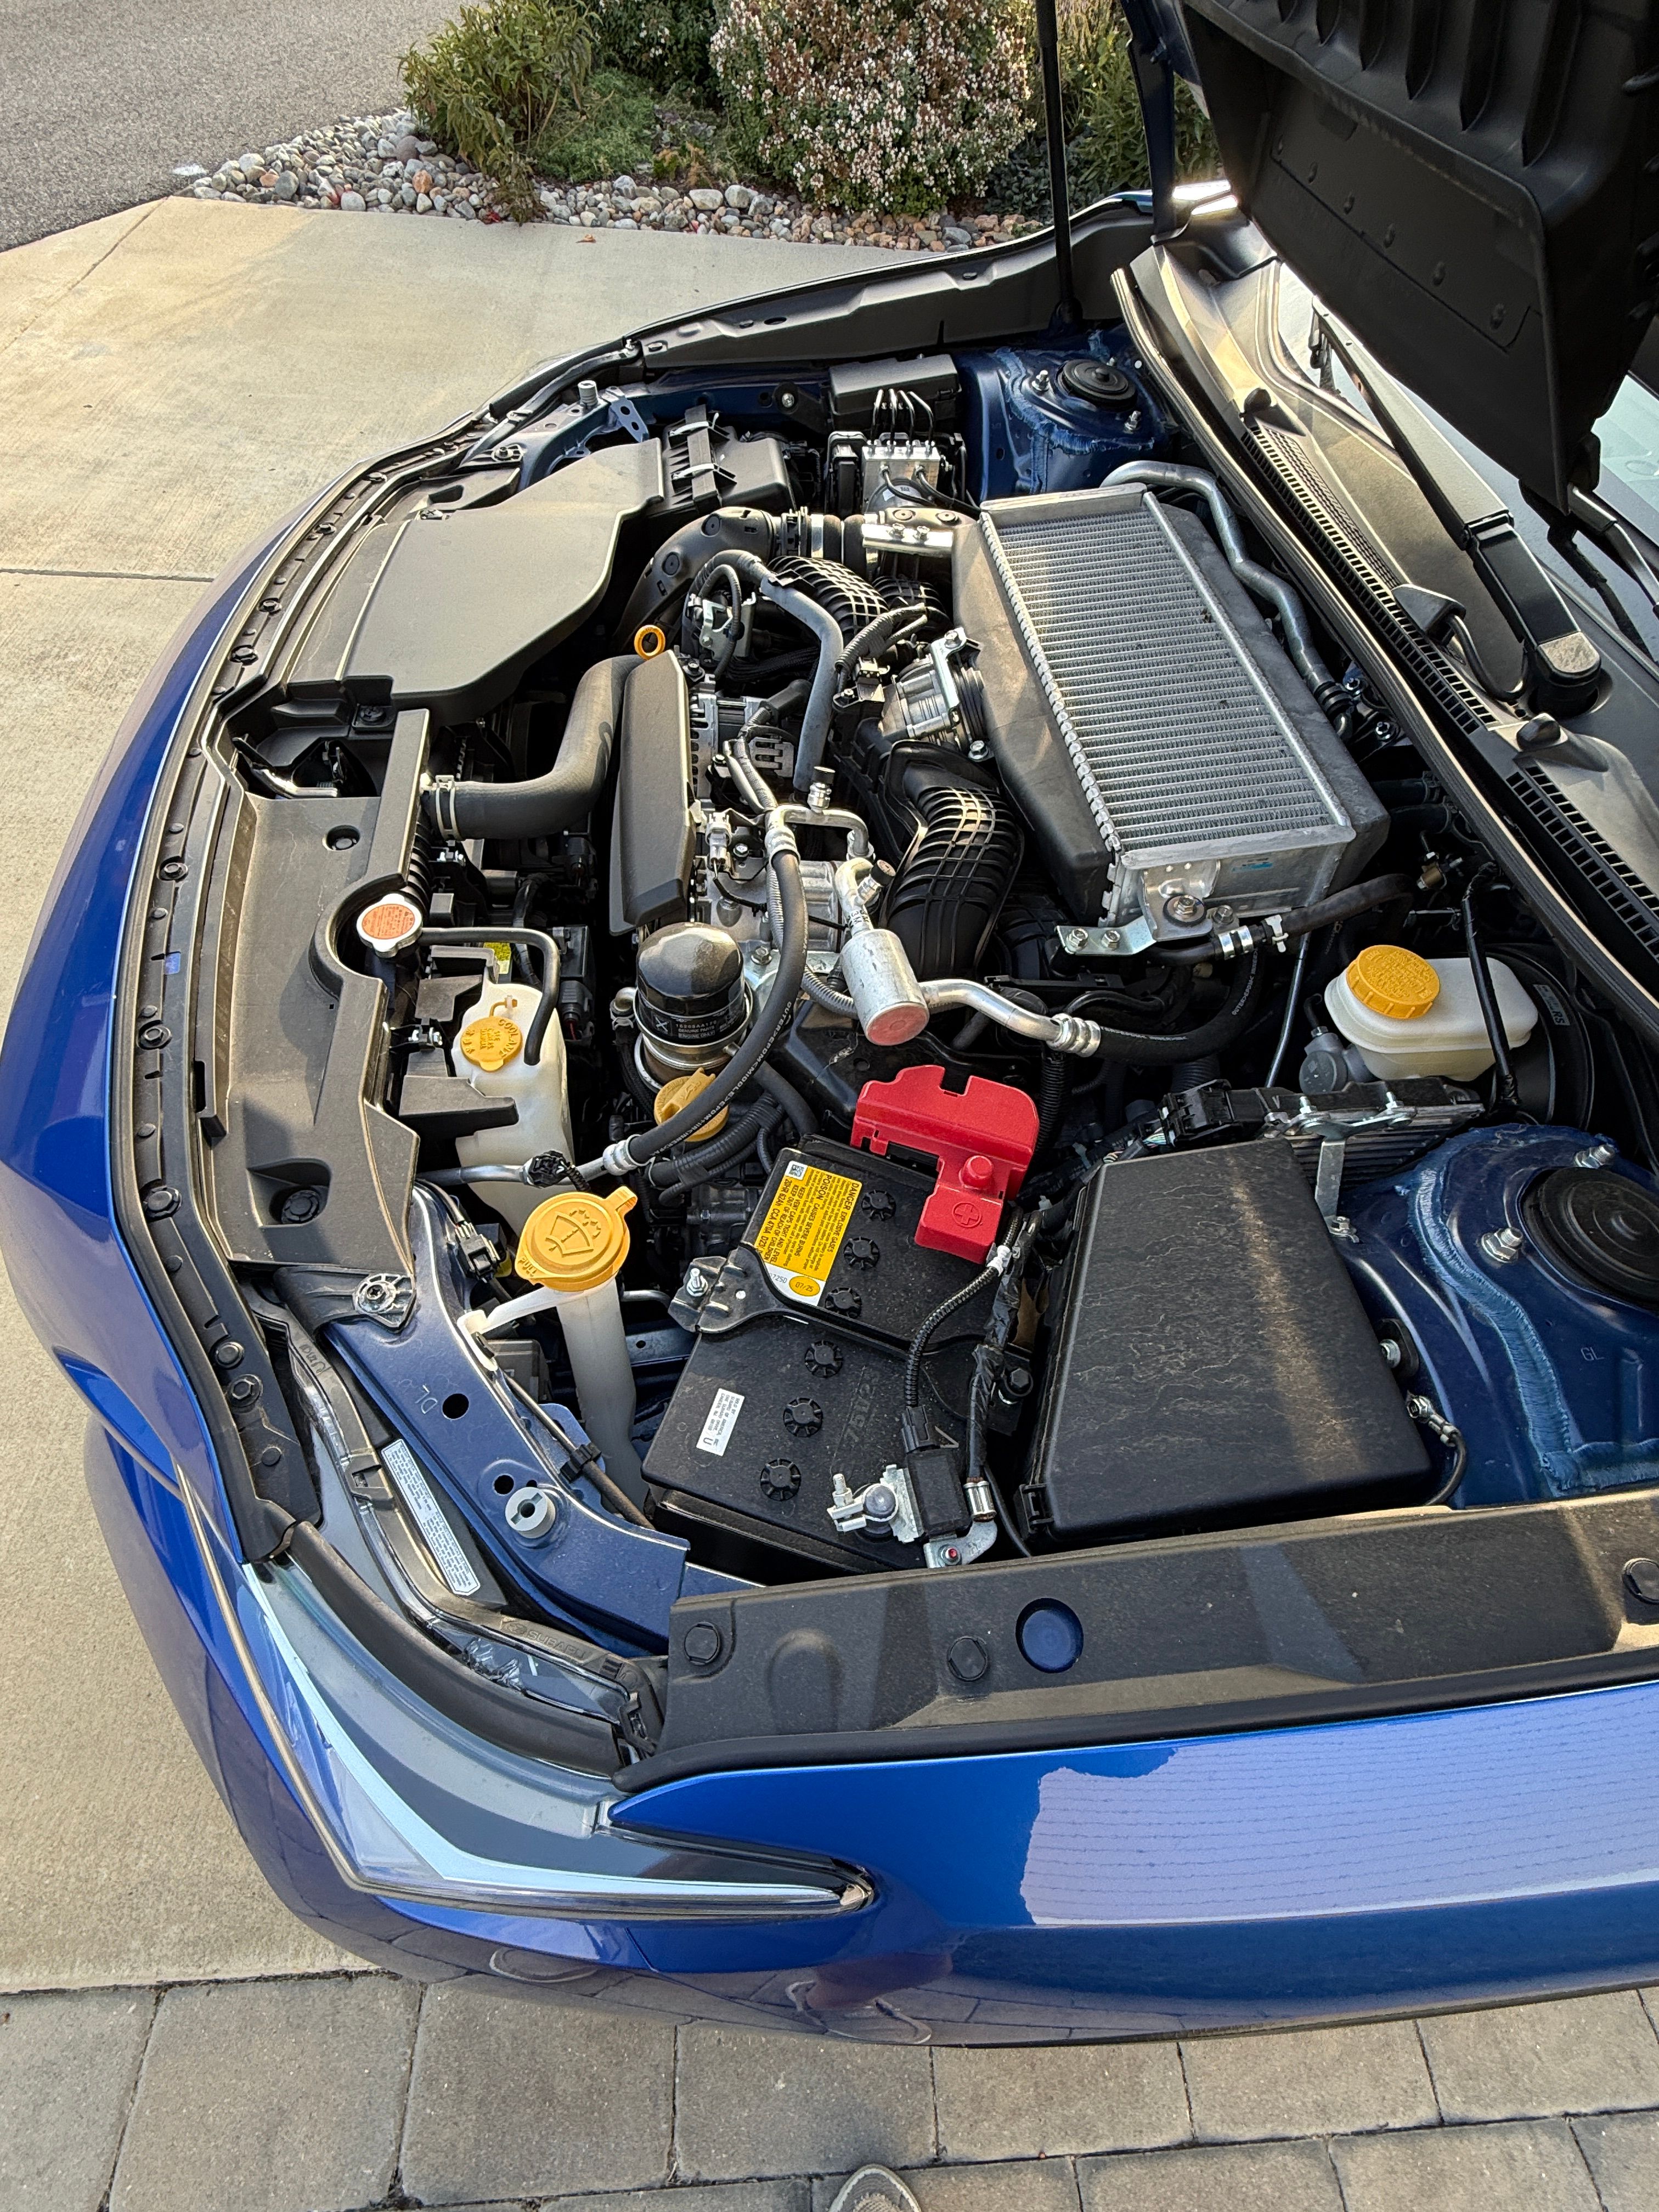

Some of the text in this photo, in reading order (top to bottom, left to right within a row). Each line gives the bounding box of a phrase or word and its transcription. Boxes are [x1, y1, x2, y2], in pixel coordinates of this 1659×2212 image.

[851, 911, 862, 924] 3M
[498, 1019, 518, 1057] COOLANT
[791, 1184, 799, 1197] KEEP
[797, 1187, 806, 1199] KEEP
[775, 1193, 786, 1206] 62Ah
[769, 1209, 780, 1220] CCA
[786, 1211, 795, 1223] CAPS
[794, 1175, 832, 1256] POISON CAUSES SEVERE BURNS
[827, 1183, 859, 1252] DANGER EXPLOSIVE GASES
[763, 1221, 774, 1233] 470A
[777, 1214, 787, 1229] REACH
[781, 1224, 791, 1237] TIGHT
[764, 1237, 777, 1260] CHILDREN
[776, 1237, 785, 1248] AND
[518, 1257, 538, 1277] PULL
[795, 1282, 813, 1293] 07/25
[1580, 1346, 1605, 1361] GL
[703, 1437, 713, 1446] U
